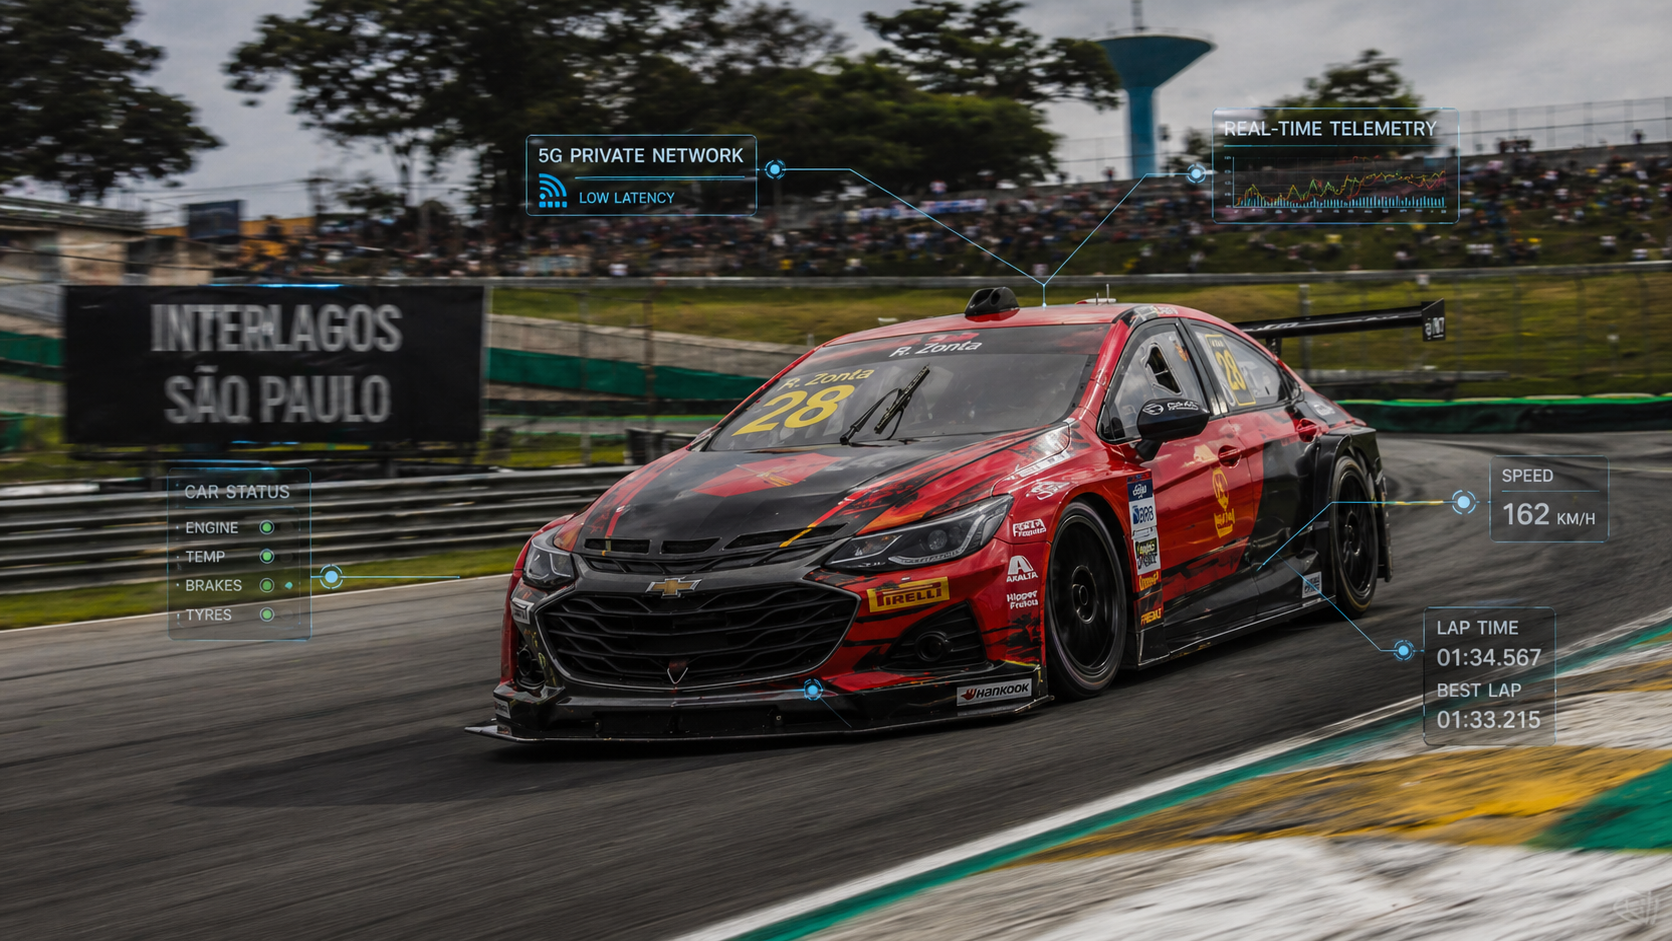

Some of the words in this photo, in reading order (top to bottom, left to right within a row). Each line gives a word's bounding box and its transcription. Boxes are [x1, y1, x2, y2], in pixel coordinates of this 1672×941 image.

[150, 304, 402, 352] INTERLAGOS
[888, 346, 912, 358] R.
[914, 340, 983, 355] Zonta
[776, 378, 801, 391] R.
[804, 369, 875, 386] Zonta
[1215, 350, 1247, 391] 28
[260, 375, 392, 423] PAULO
[731, 384, 855, 436] 28
[876, 582, 942, 607] PIRELLI
